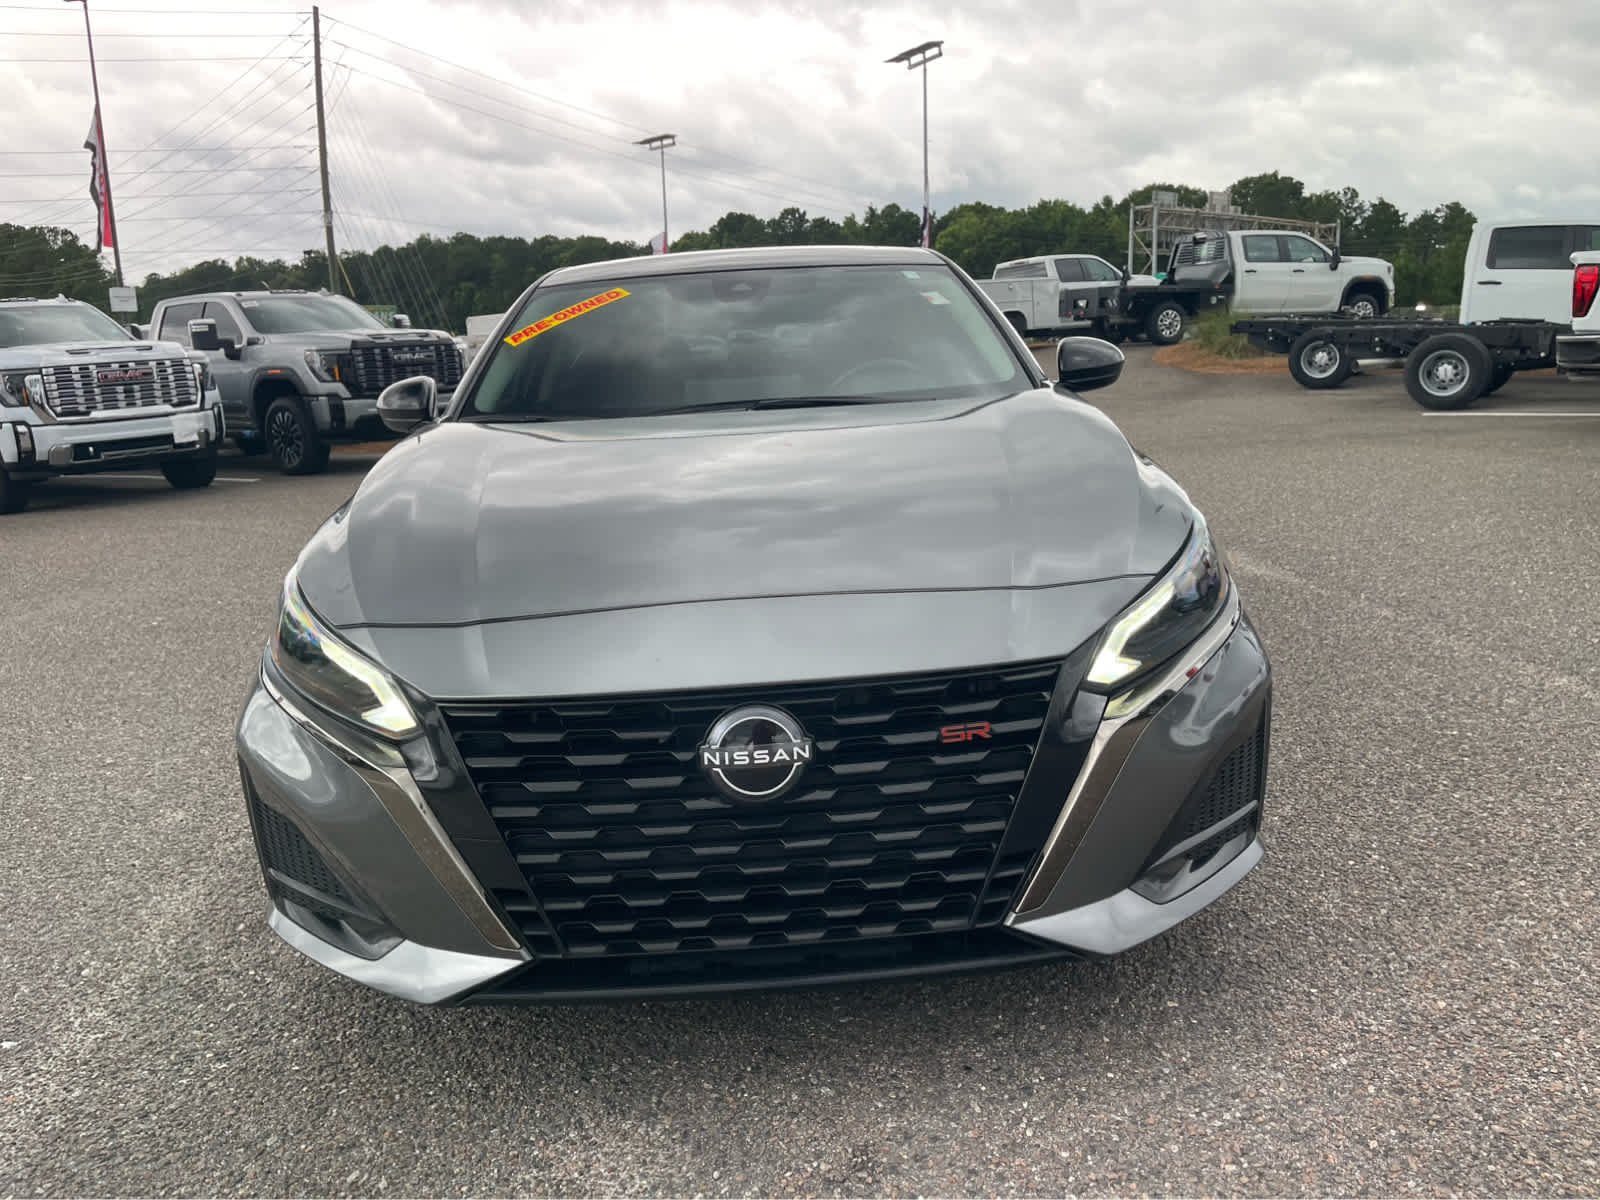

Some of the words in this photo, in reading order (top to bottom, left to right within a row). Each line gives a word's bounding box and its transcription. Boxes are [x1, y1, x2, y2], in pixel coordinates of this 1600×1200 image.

[511, 290, 622, 343] PRE-OWNED
[941, 721, 992, 743] SR
[703, 745, 809, 765] NISSAN
